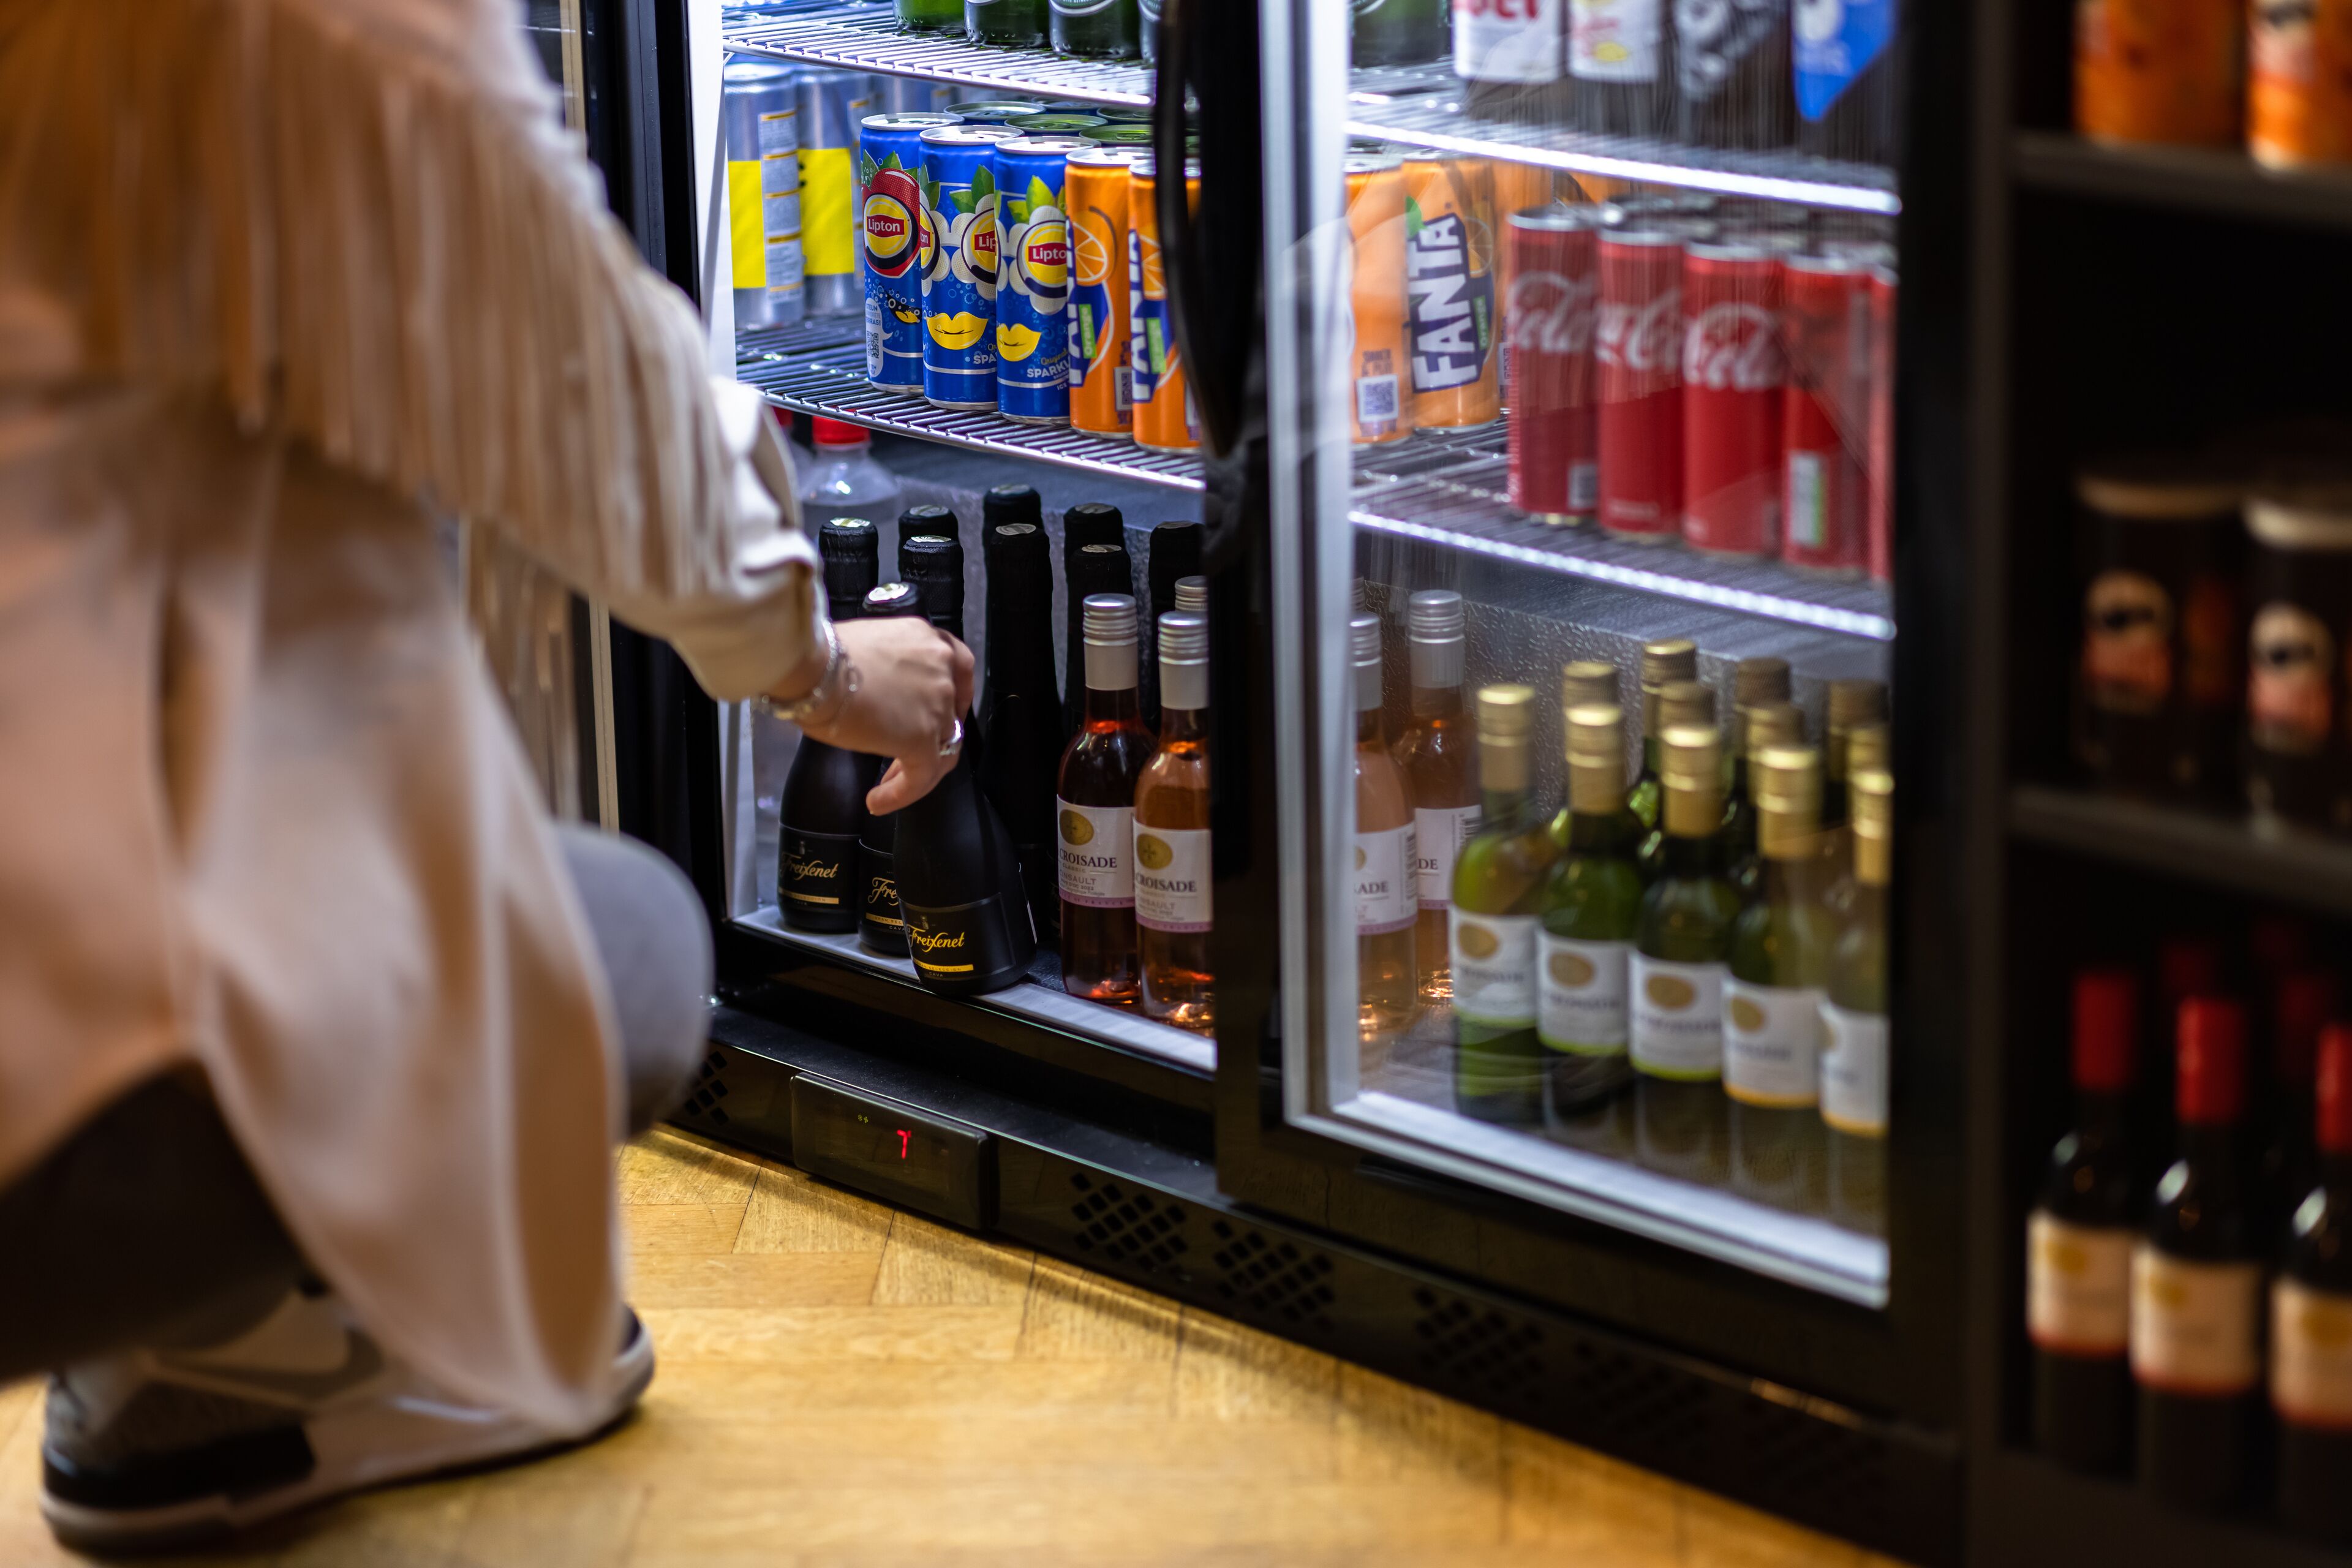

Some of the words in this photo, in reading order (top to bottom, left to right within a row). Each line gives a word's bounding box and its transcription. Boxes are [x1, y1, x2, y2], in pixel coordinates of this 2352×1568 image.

[868, 218, 900, 232] Lipton
[920, 231, 929, 244] ton
[979, 235, 995, 249] Lip
[1032, 247, 1066, 262] Lipto
[1407, 216, 1478, 390] FANTA
[1027, 360, 1069, 378] SPARKL
[1059, 848, 1117, 868] CROISADE
[907, 924, 965, 952] Freixenet
